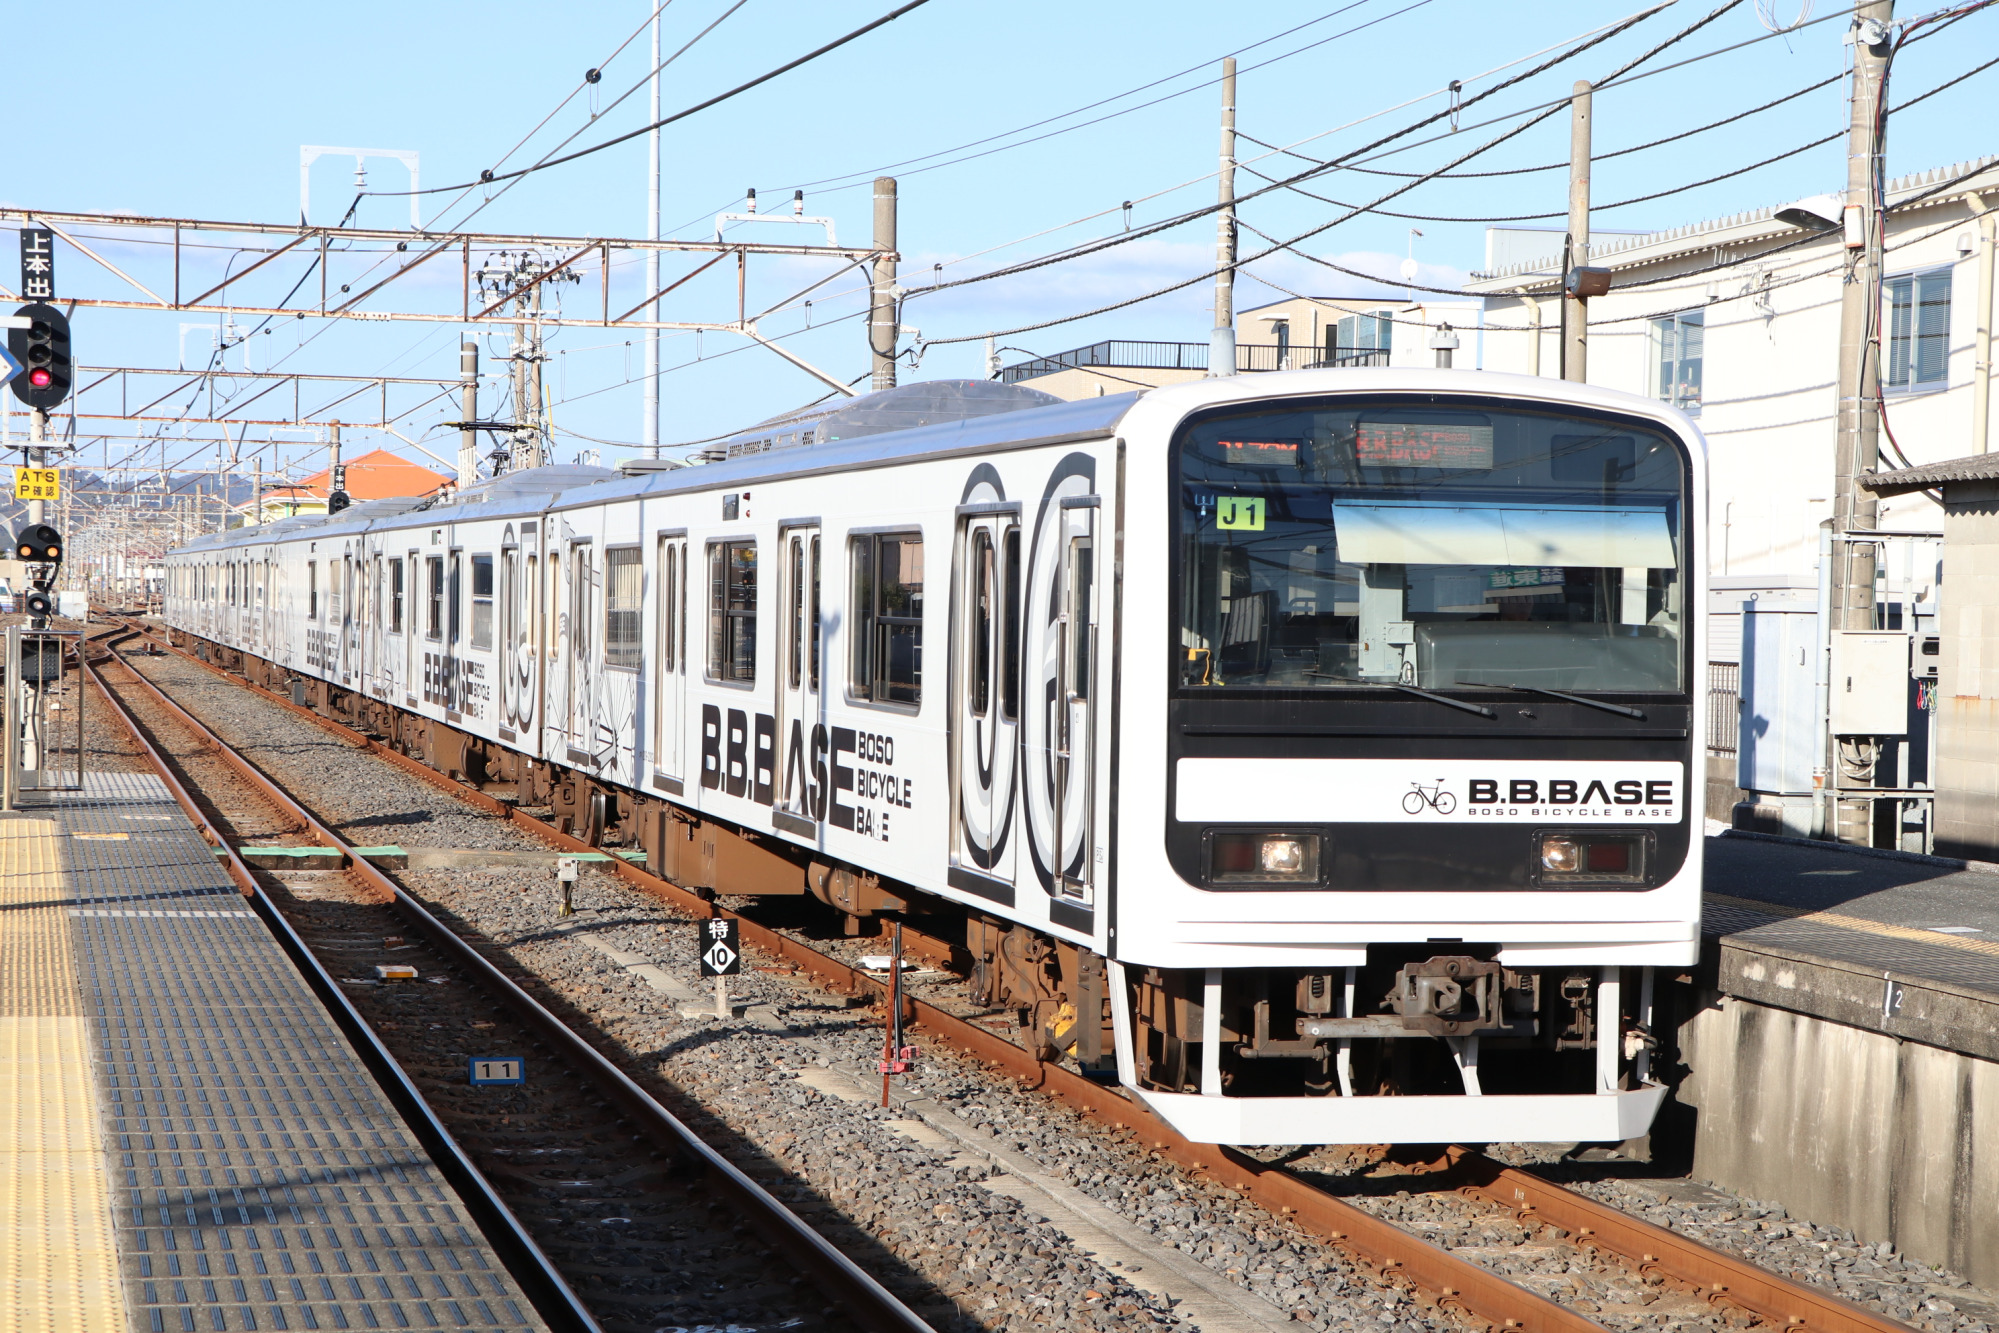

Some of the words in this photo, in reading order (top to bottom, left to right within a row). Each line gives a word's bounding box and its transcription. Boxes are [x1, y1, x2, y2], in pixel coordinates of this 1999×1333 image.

[25, 232, 50, 298] 上本出
[20, 471, 55, 483] ATS
[858, 731, 894, 766] BOSO
[701, 703, 856, 832] B.B.BASE
[857, 768, 912, 809] BICYCLE
[1469, 779, 1673, 805] B.B.BASE
[1468, 808, 1518, 816] BOSO
[1531, 808, 1612, 816] BICYCLE
[1624, 808, 1673, 817] BASE
[708, 920, 729, 940] 特
[711, 947, 728, 967] 10
[1894, 989, 1903, 1009] 2
[482, 1063, 511, 1078] 11
